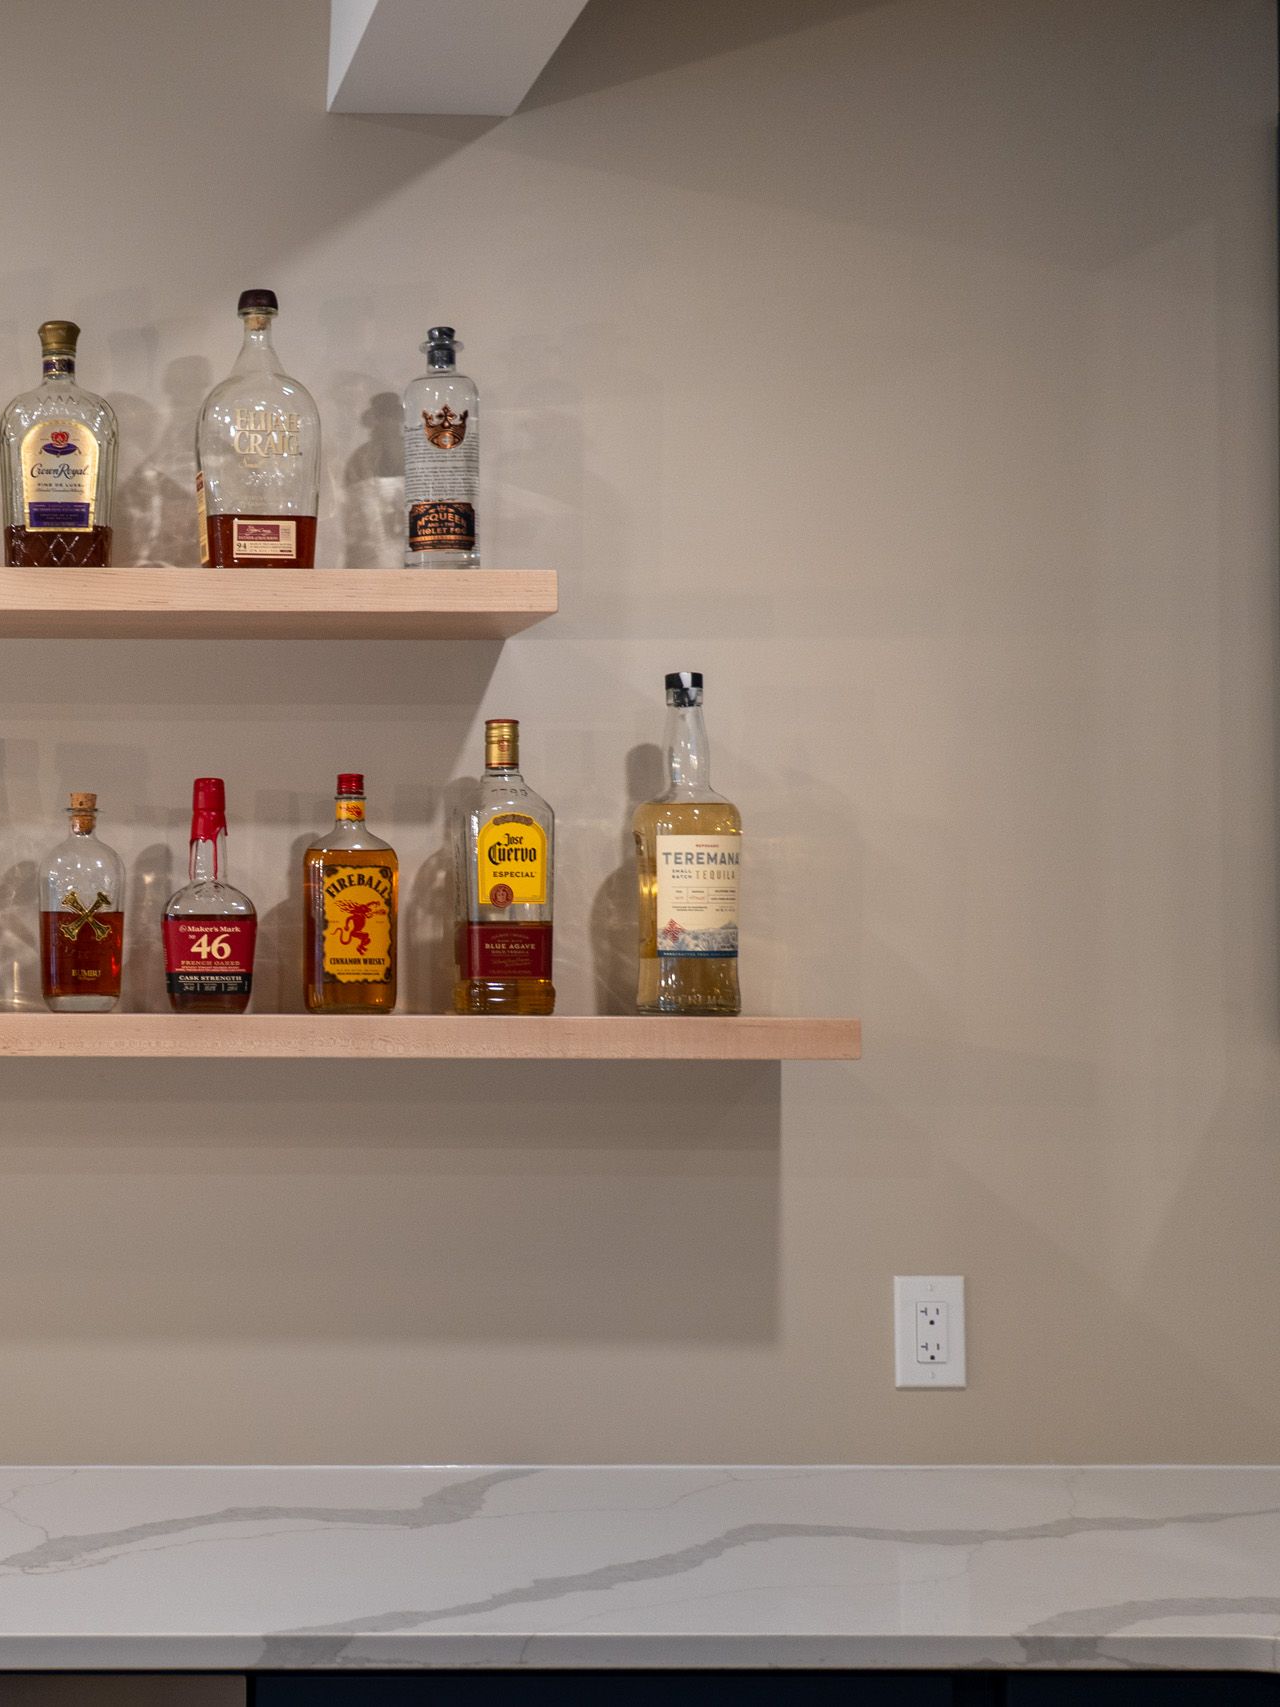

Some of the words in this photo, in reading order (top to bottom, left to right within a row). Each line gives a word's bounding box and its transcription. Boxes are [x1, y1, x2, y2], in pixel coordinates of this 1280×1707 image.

[234, 430, 300, 457] CRAIG
[31, 463, 59, 478] Crown
[57, 463, 89, 480] Royal
[488, 841, 537, 866] Cuervo
[662, 852, 740, 865] TEREMANA
[325, 873, 389, 898] FIREBALL
[695, 870, 735, 880] TEQUILA
[190, 933, 232, 960] 46
